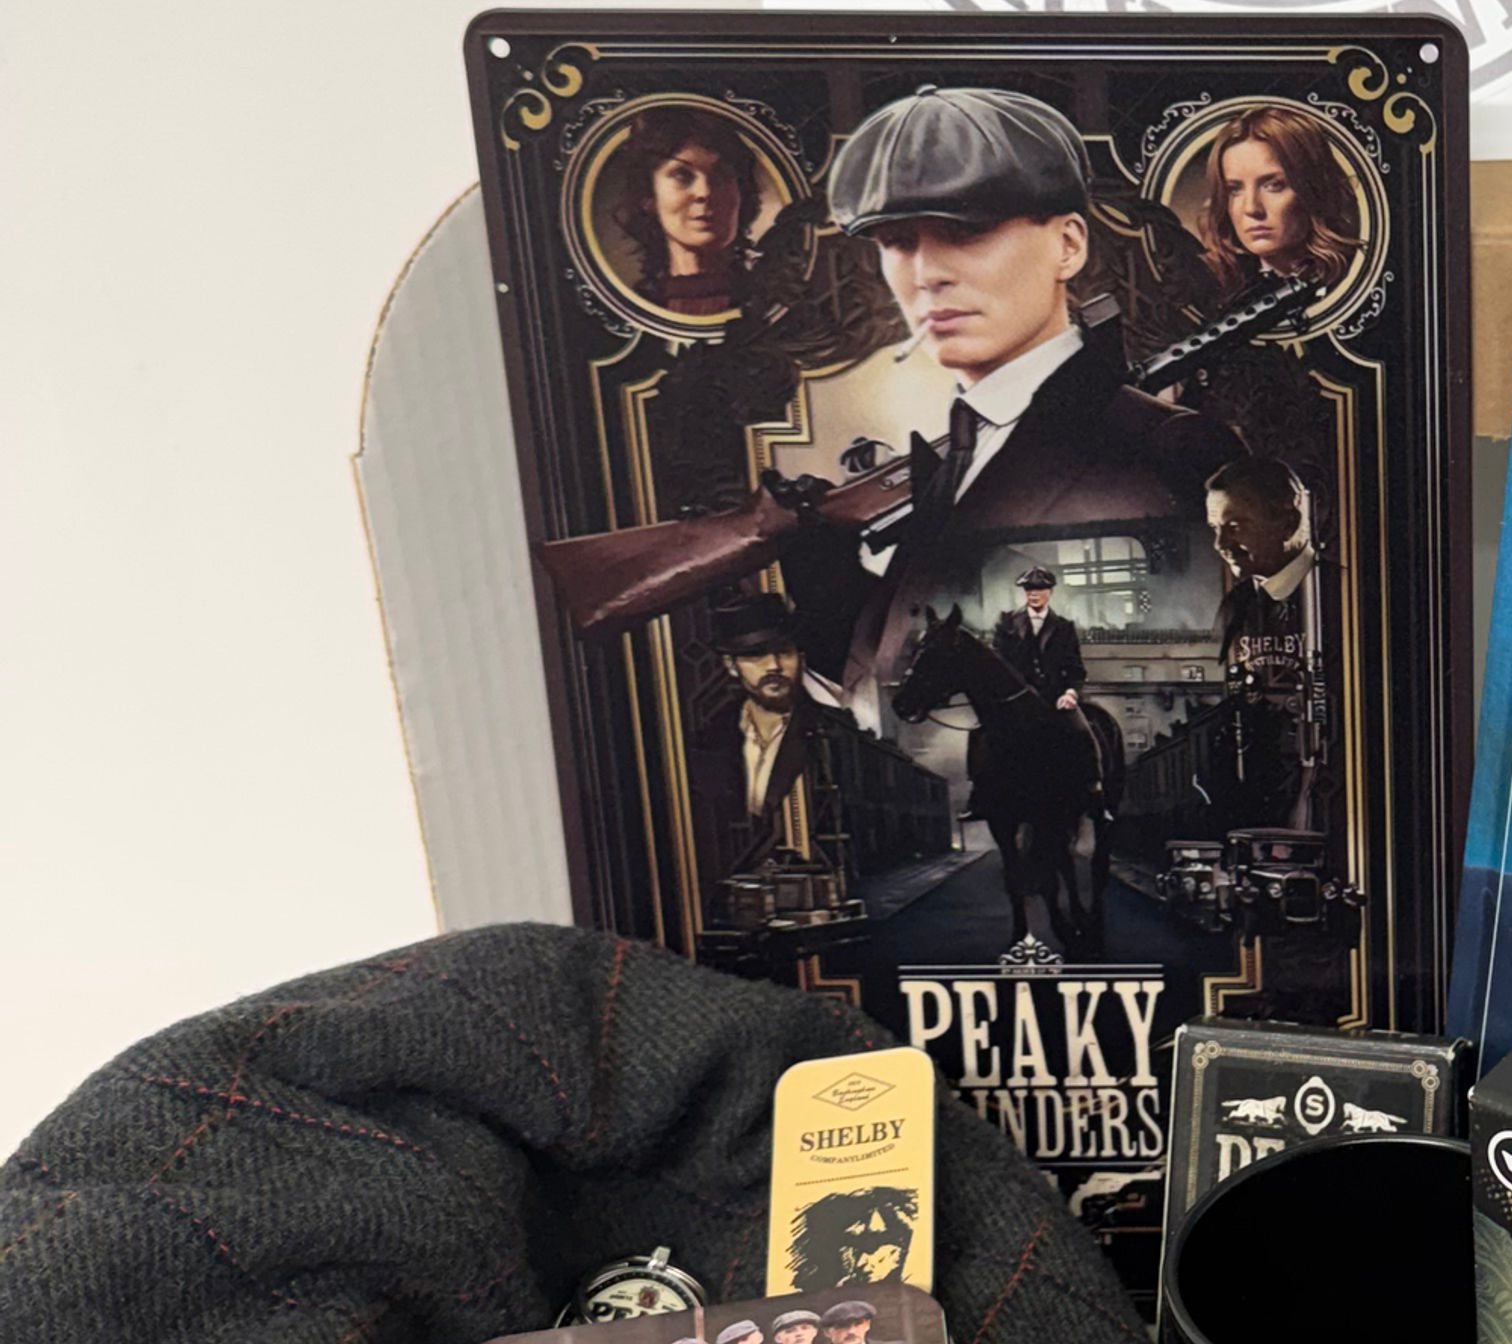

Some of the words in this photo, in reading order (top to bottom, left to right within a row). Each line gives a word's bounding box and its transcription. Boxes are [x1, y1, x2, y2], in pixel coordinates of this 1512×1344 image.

[1238, 633, 1306, 662] SHELBY
[900, 981, 1165, 1087] PEAKY
[1304, 1094, 1325, 1116] S
[800, 1118, 906, 1152] SHELBY
[951, 1089, 1165, 1158] NDERS
